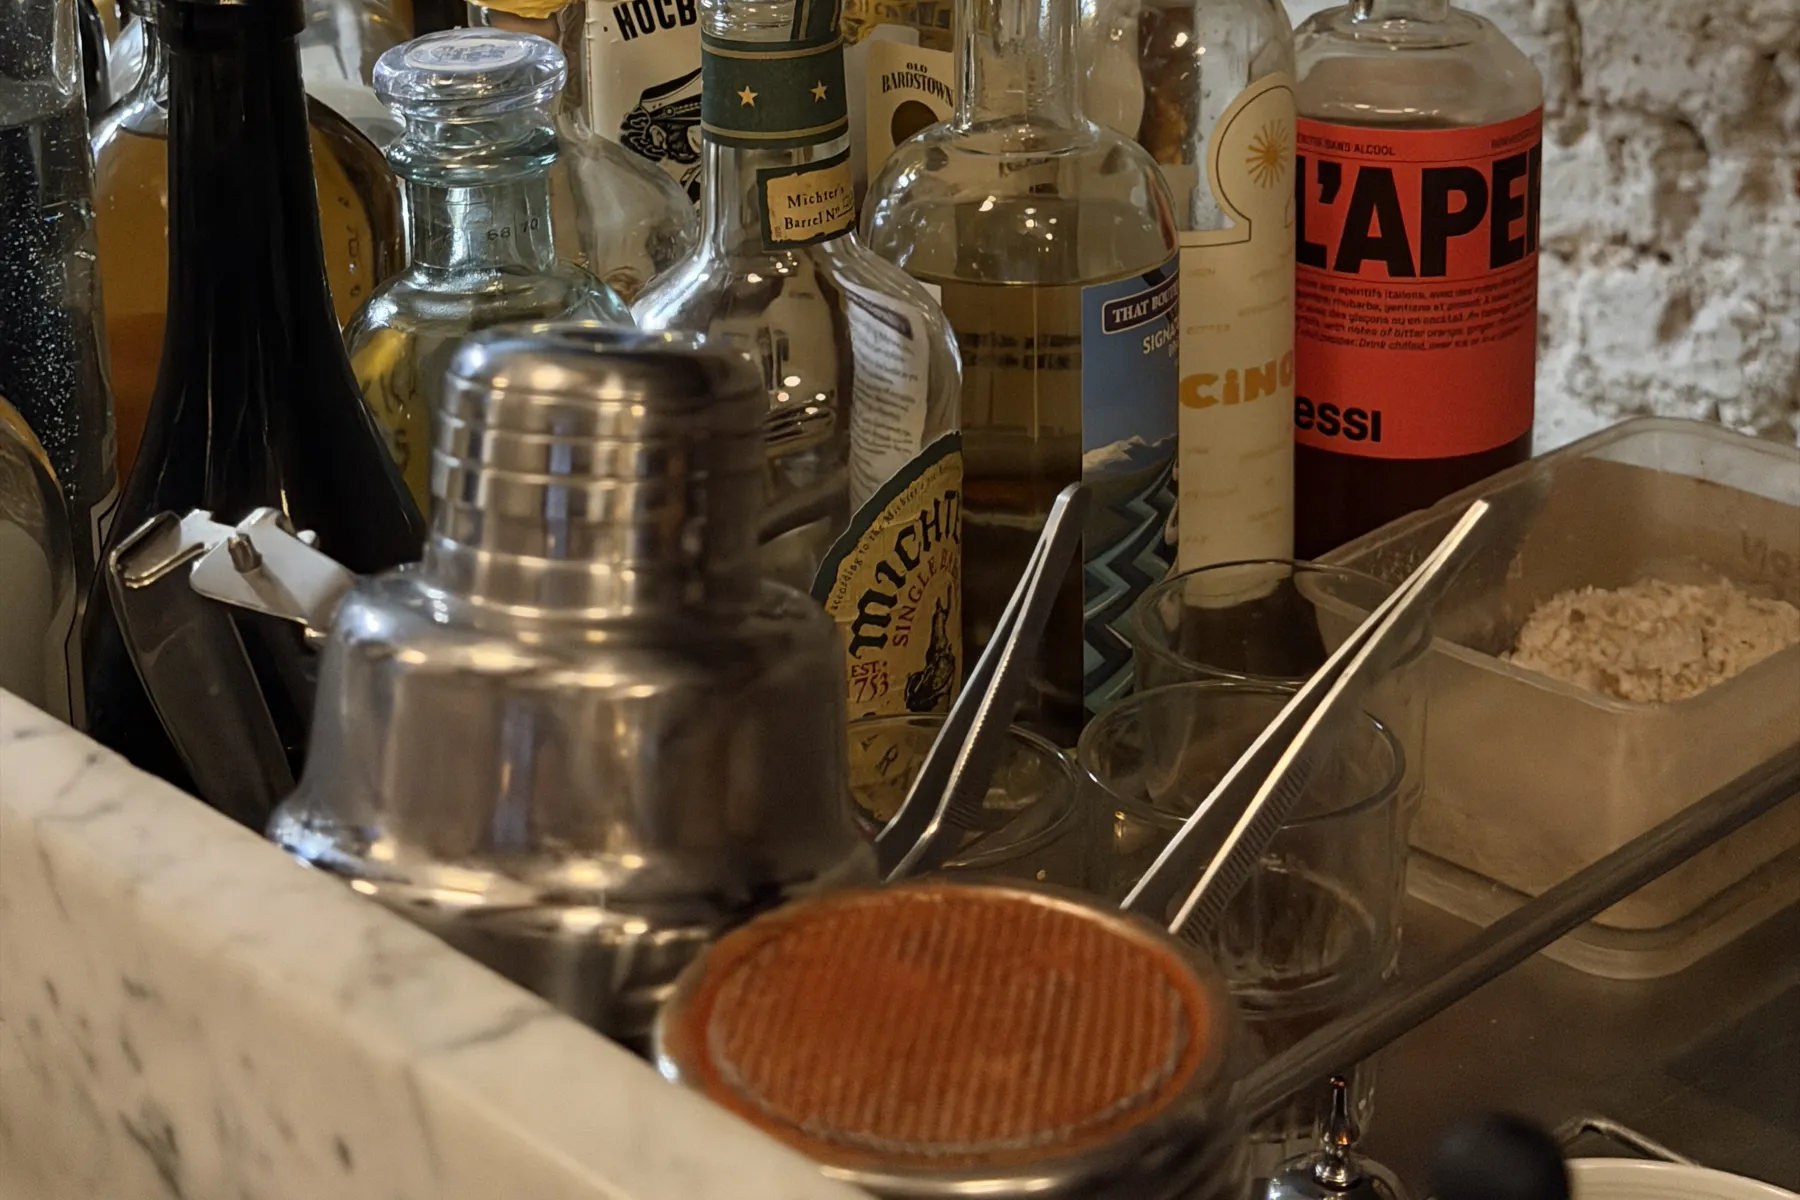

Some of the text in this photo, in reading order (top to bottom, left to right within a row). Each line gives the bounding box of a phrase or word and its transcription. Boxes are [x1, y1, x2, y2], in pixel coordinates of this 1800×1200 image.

[906, 62, 928, 73] OLD
[881, 71, 953, 108] BARDSTOWN
[1324, 138, 1351, 153] SANS
[1353, 143, 1396, 156] ALCOOL
[784, 212, 822, 230] Barrel
[1112, 299, 1149, 323] THAT
[1347, 325, 1378, 337] notes
[1379, 326, 1393, 337] of
[1394, 327, 1425, 339] bitter
[1358, 338, 1387, 351] Drink
[893, 556, 938, 649] SINGLE
